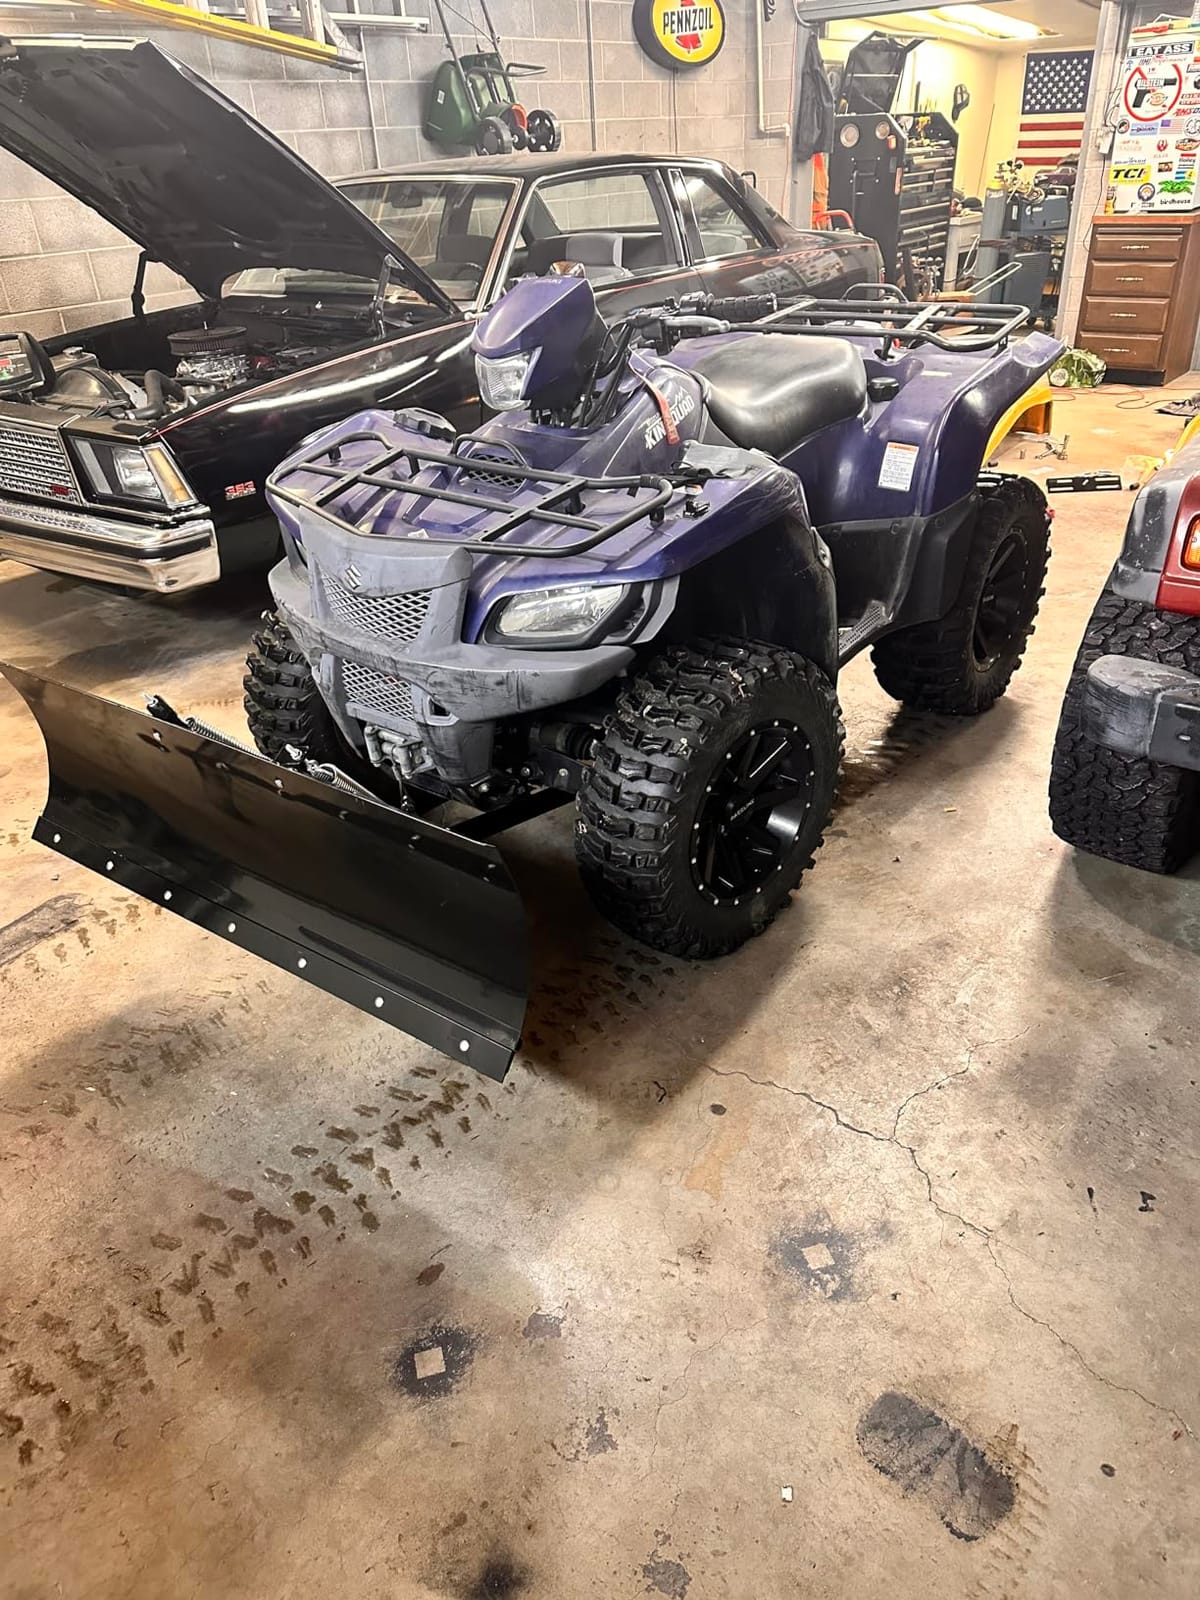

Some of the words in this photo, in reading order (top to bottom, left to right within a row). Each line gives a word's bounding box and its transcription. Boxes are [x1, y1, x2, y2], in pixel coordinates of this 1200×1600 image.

[663, 7, 713, 35] PENNZOIL
[1128, 48, 1133, 57] I
[1136, 46, 1161, 56] EAT
[1163, 43, 1190, 54] ASS
[1113, 168, 1145, 179] TCI
